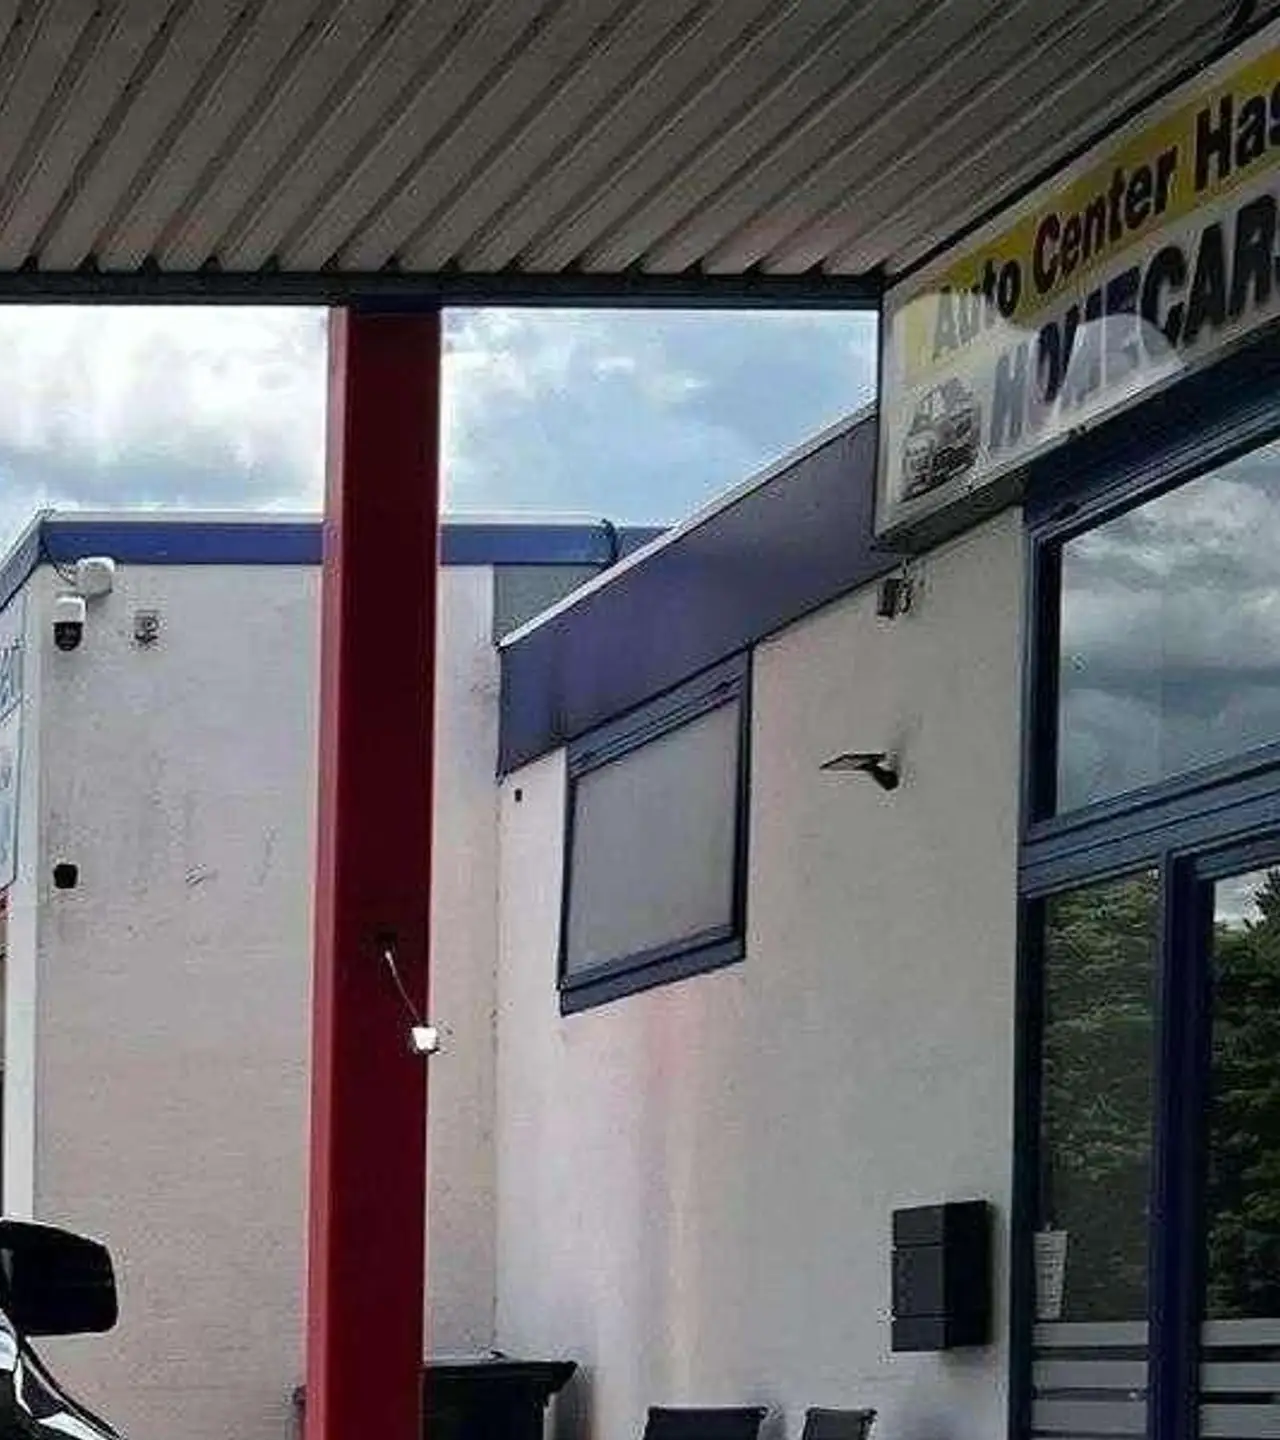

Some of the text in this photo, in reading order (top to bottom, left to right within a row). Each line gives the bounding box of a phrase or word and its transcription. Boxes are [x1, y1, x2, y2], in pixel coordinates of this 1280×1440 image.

[934, 258, 1022, 362] Auto
[1033, 146, 1179, 294] Center
[989, 192, 1280, 448] HOMECAR
